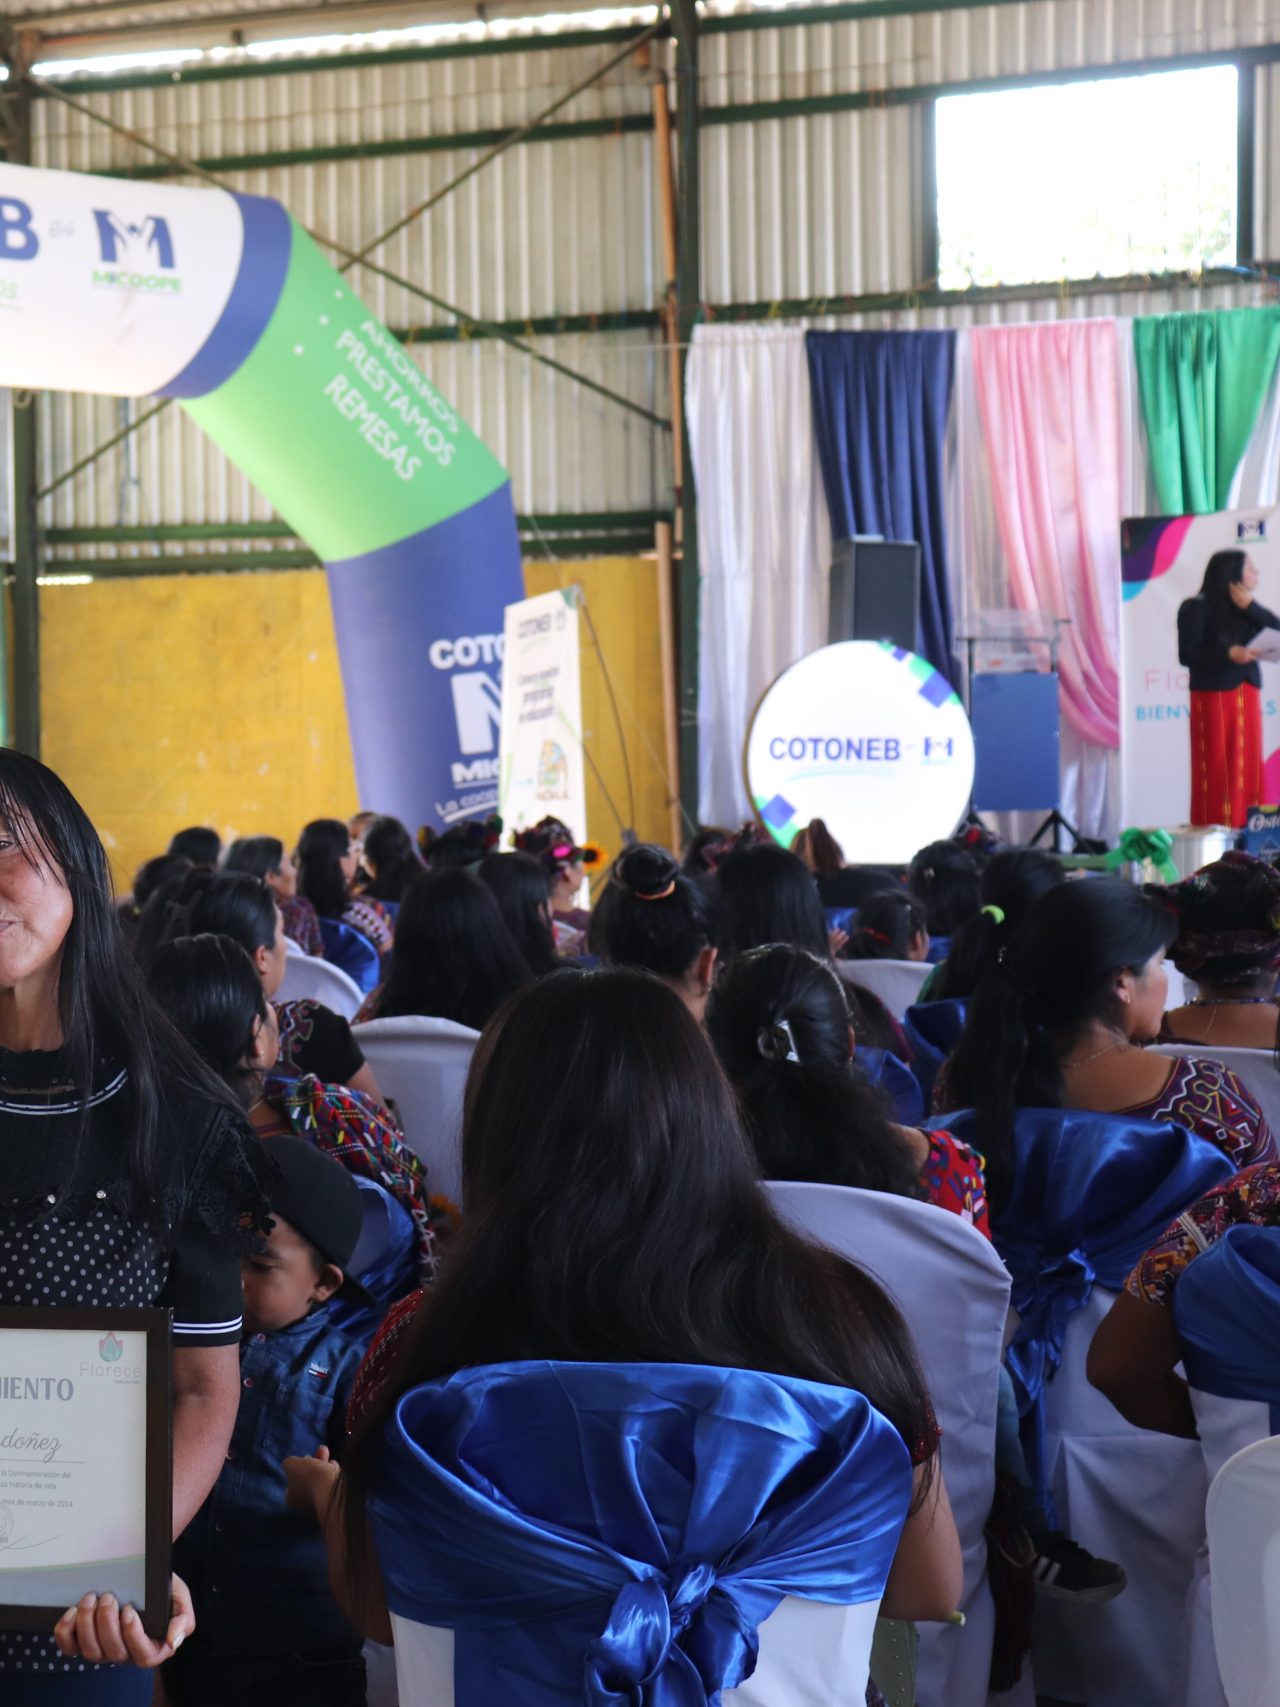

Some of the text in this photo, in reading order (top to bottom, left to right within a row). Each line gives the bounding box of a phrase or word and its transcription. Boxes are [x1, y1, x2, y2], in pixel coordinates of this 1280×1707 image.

[92, 270, 182, 291] MICOOPE
[323, 373, 422, 481] REMESAS
[335, 328, 456, 466] PRESTAMOS
[769, 736, 901, 761] COTONEB
